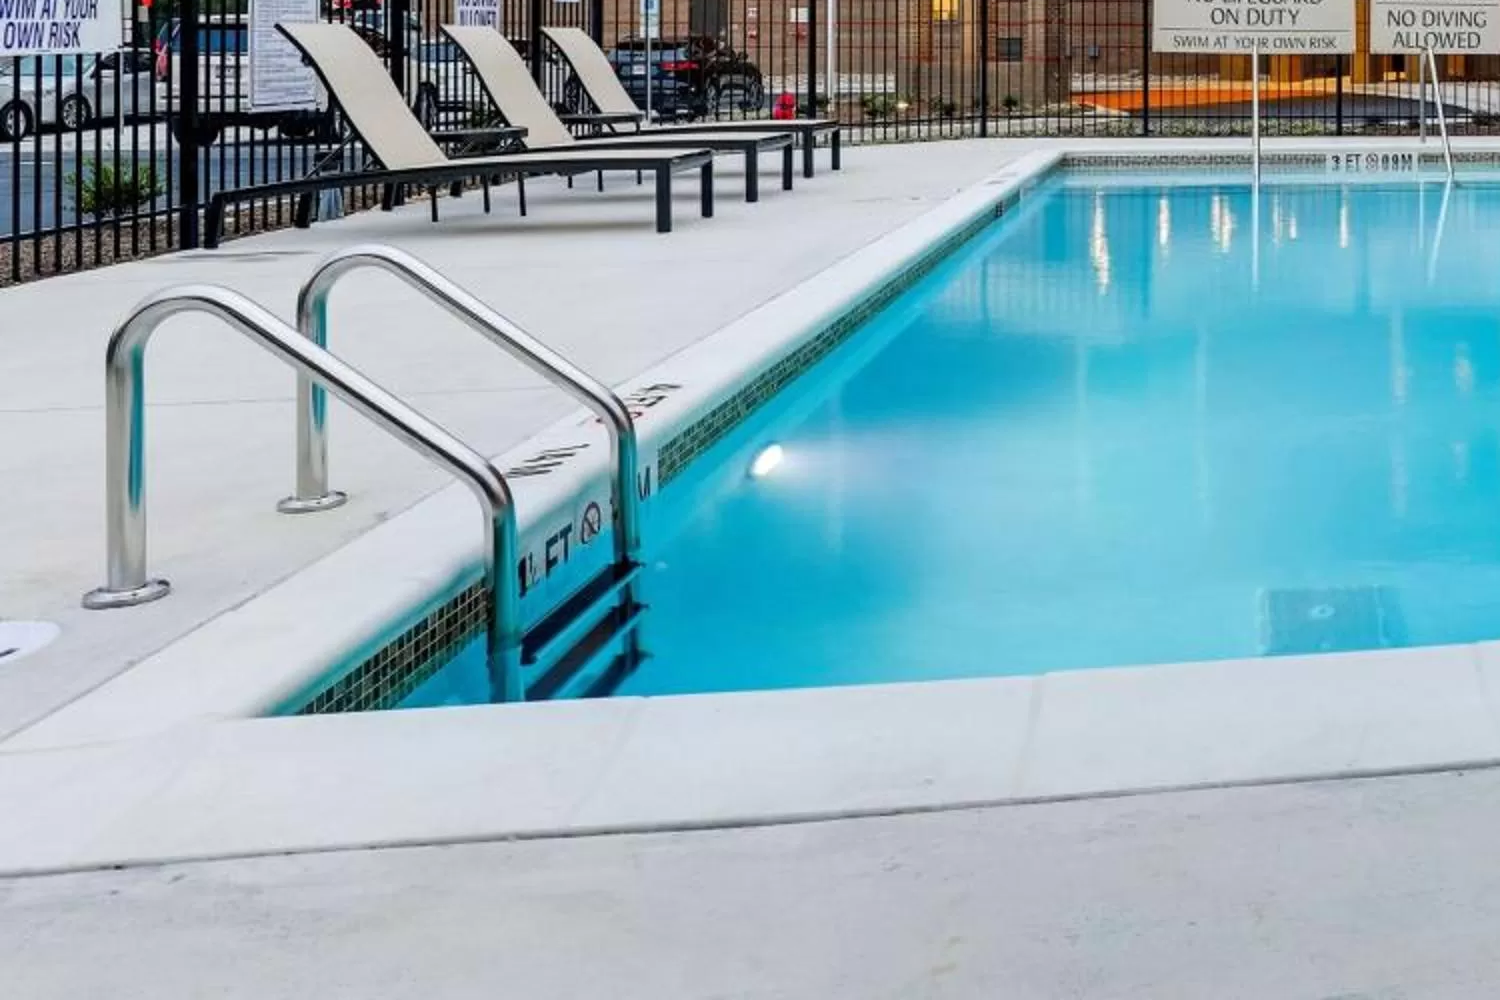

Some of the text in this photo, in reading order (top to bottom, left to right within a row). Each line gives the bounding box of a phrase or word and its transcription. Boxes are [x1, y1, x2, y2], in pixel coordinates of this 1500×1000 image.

[1211, 7, 1300, 27] ON DUTY
[1387, 9, 1487, 29] NO DIVING
[4, 21, 81, 49] OWN RISK
[1173, 35, 1337, 49] SWIM AT YOUR OWN RISK
[1392, 31, 1481, 50] ALLOWED
[1345, 153, 1361, 171] FT
[545, 523, 573, 577] FT
